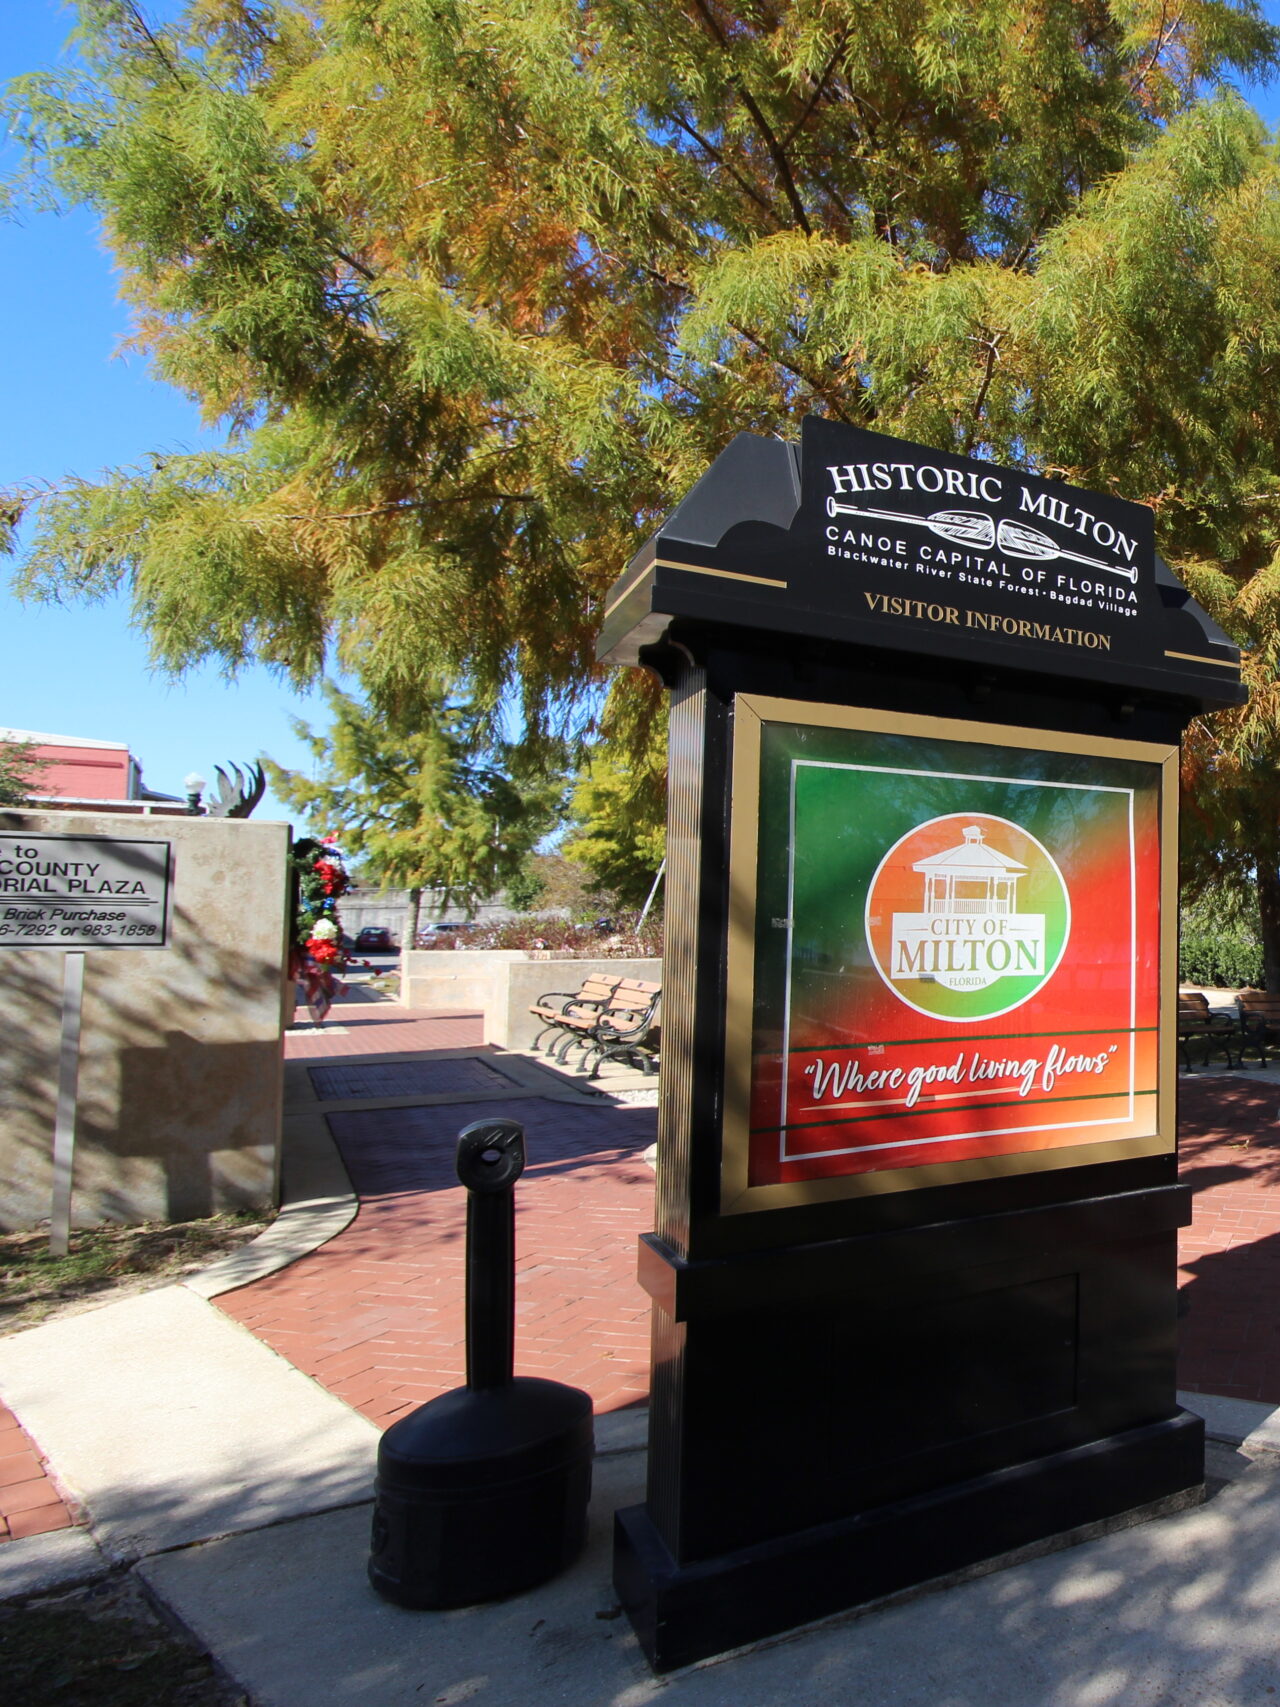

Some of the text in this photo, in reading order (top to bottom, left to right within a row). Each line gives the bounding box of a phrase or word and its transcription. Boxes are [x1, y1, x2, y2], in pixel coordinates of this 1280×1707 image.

[826, 463, 1138, 562] HISTORIC MILTON
[826, 526, 1138, 603] CANOE CAPITAL OF FLORIDA
[827, 545, 1138, 616] Blackwater River State Forest Bagdad Village
[863, 592, 1112, 651] VISITOR INFORMATION
[14, 845, 38, 859] to
[0, 860, 100, 877] COUNTY
[0, 878, 147, 894] RIAL PLAZA
[3, 908, 127, 921] Brick Purchase
[0, 924, 157, 937] 6-7292 or 983-1858
[930, 918, 1008, 935] CITY OF
[896, 939, 1040, 973] MILTON
[949, 977, 987, 987] FLORIDA
[906, 1053, 967, 1108] good
[968, 1052, 1042, 1097] living
